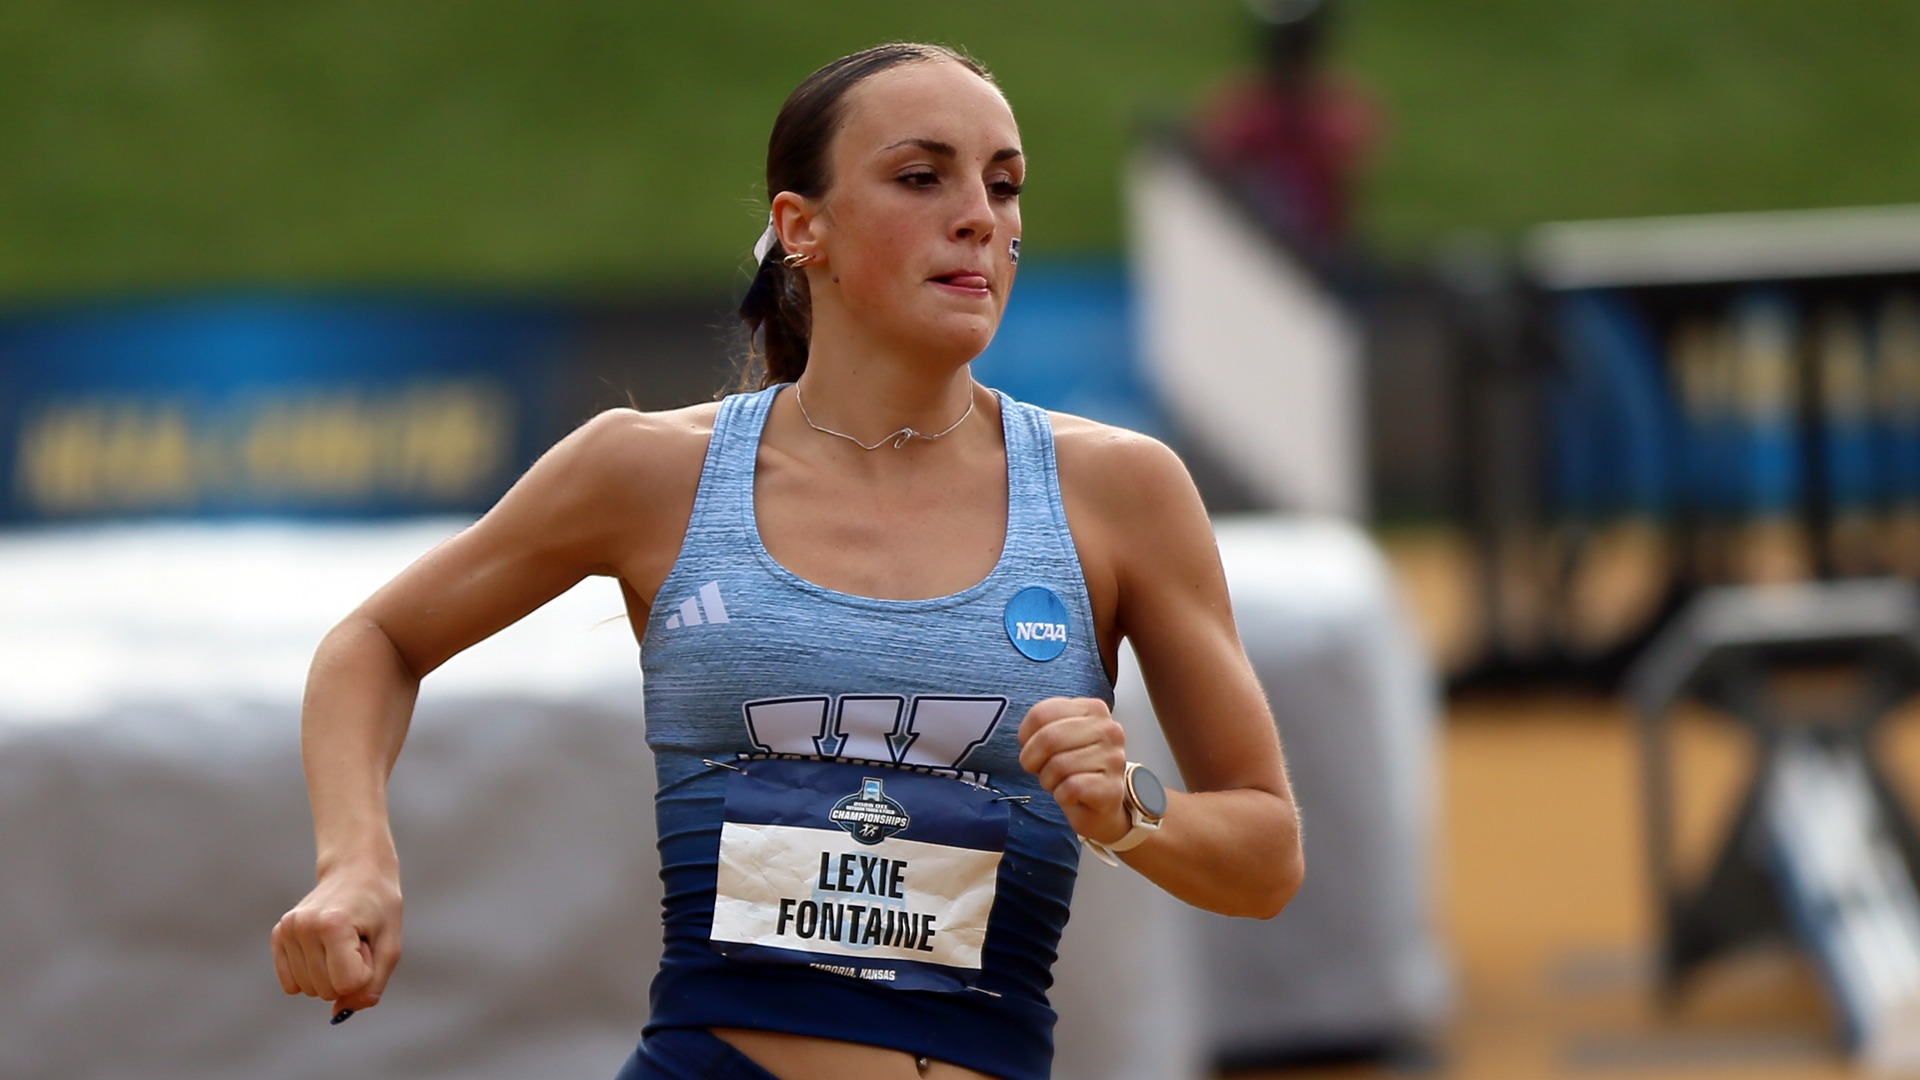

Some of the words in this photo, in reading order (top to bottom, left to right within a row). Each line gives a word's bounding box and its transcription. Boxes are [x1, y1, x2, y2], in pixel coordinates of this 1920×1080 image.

[1015, 622, 1067, 642] NCAA
[832, 810, 907, 827] CHAMPIONSHIPS
[818, 851, 908, 899] LEXIE
[776, 898, 937, 952] FONTAINE
[860, 968, 896, 981] KANSAS
